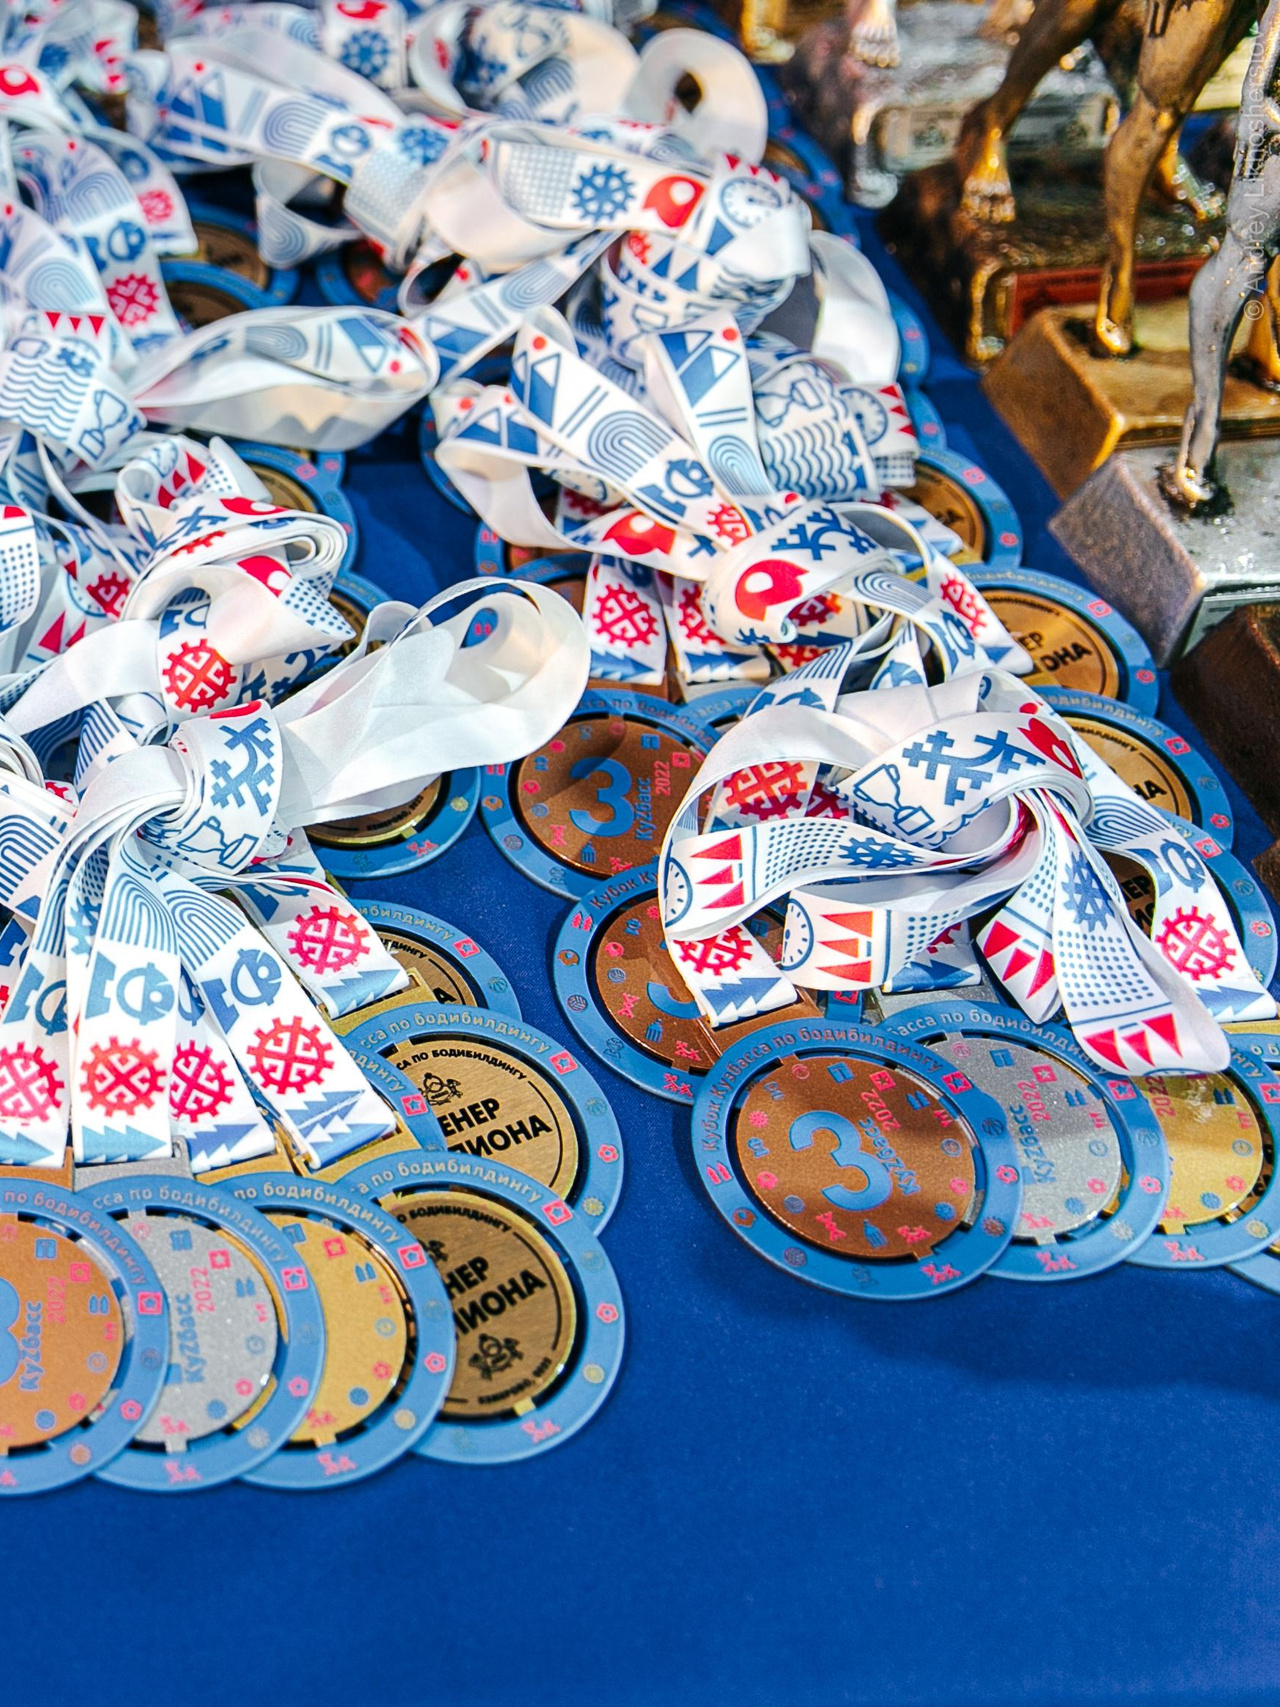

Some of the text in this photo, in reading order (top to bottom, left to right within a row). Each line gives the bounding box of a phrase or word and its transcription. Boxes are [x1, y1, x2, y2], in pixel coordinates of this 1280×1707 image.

[568, 756, 635, 838] 3
[653, 761, 671, 797] 2022
[590, 875, 637, 910] Кубок
[359, 905, 455, 940] ибилдингу
[389, 1019, 410, 1034] по
[414, 1012, 550, 1052] бодибилдингу
[900, 1015, 937, 1036] асса
[941, 1012, 964, 1024] по
[412, 1048, 527, 1081] ПО БОДИБИЛДИНГУ
[701, 1027, 943, 1151] Кубок Кузбасса по бодибилдингу
[859, 1089, 901, 1131] 2022
[1016, 1080, 1052, 1122] 2022
[437, 1097, 500, 1138] ЕНЕР
[789, 1110, 892, 1211] 3
[370, 1161, 542, 1204] по бодибилдингу
[129, 1187, 153, 1200] по
[159, 1186, 289, 1262] бодибилдингу
[233, 1183, 404, 1243] по бодибилдингу
[409, 1205, 512, 1233] БОДИБИЛДИНГУ
[4, 1190, 28, 1204] по
[33, 1192, 148, 1286] бодибилдингу
[189, 1266, 216, 1314] 2022
[446, 1256, 490, 1301] НЕР
[47, 1276, 67, 1325] 2022
[458, 1269, 548, 1337] ИОНА
